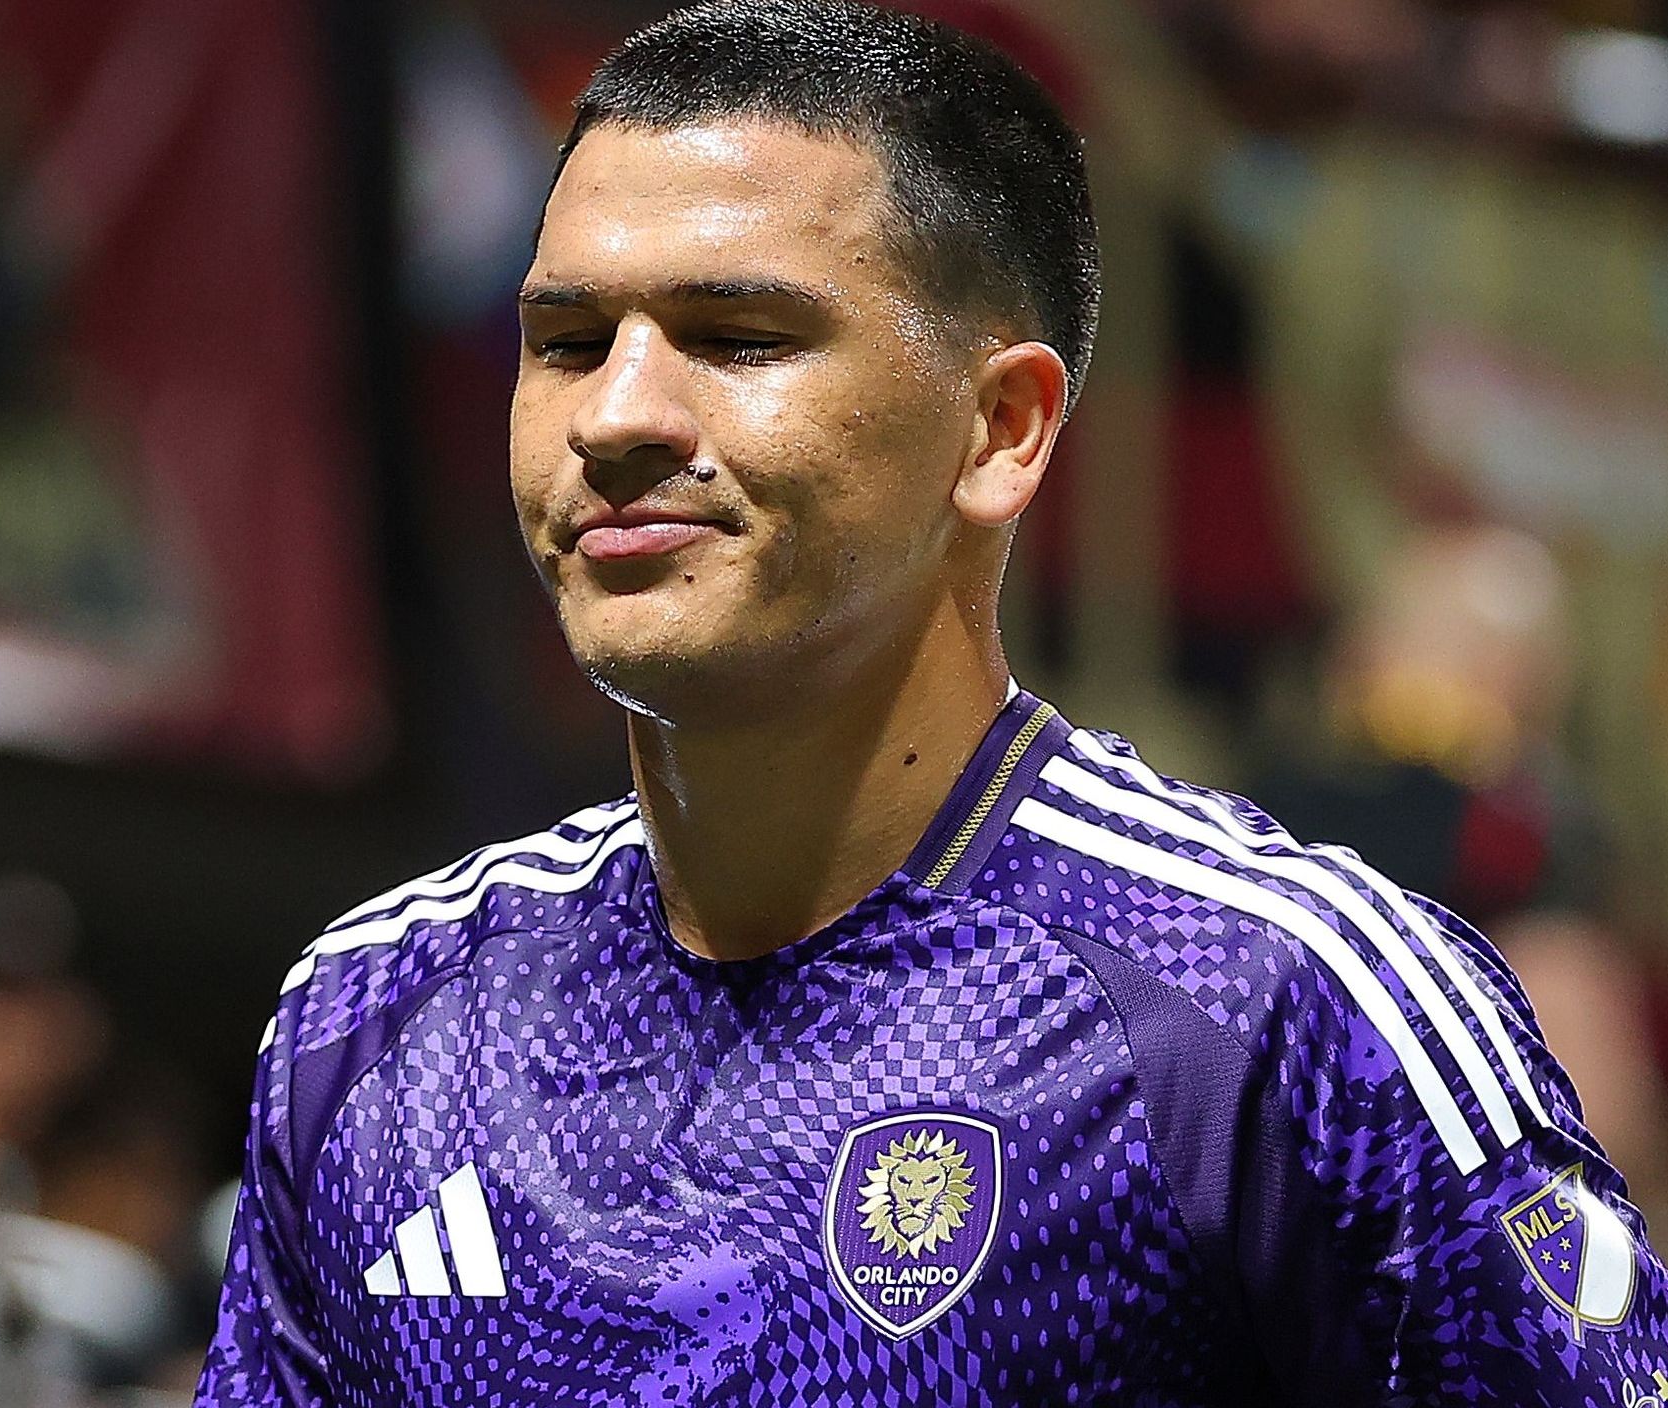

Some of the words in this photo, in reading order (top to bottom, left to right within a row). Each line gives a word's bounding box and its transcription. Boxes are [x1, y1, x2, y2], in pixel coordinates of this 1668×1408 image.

[1515, 1193, 1578, 1249] MLS
[853, 1265, 959, 1285] ORLANDO
[880, 1286, 927, 1305] CITY
